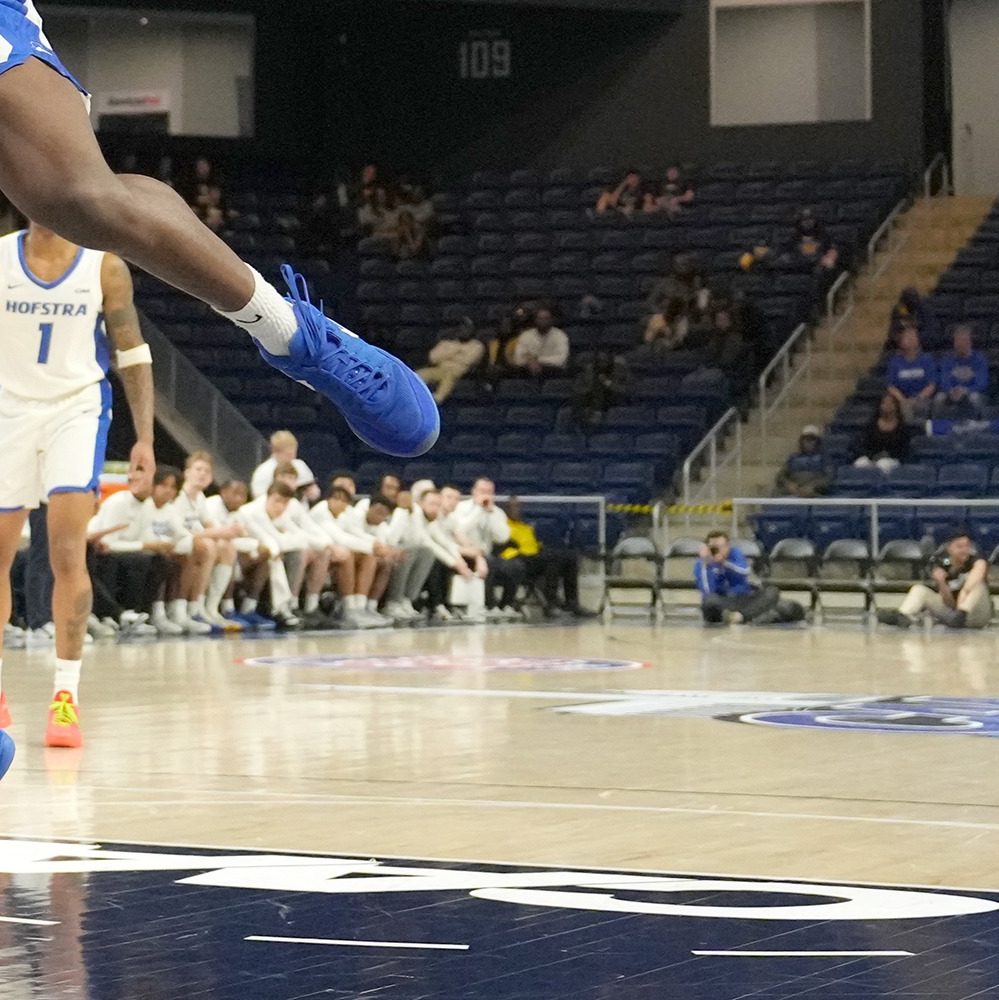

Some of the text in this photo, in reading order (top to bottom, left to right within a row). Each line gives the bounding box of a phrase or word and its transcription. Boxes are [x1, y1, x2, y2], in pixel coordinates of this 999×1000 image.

[460, 40, 510, 78] 109
[5, 300, 87, 316] HOFSTRA
[37, 322, 53, 364] 1
